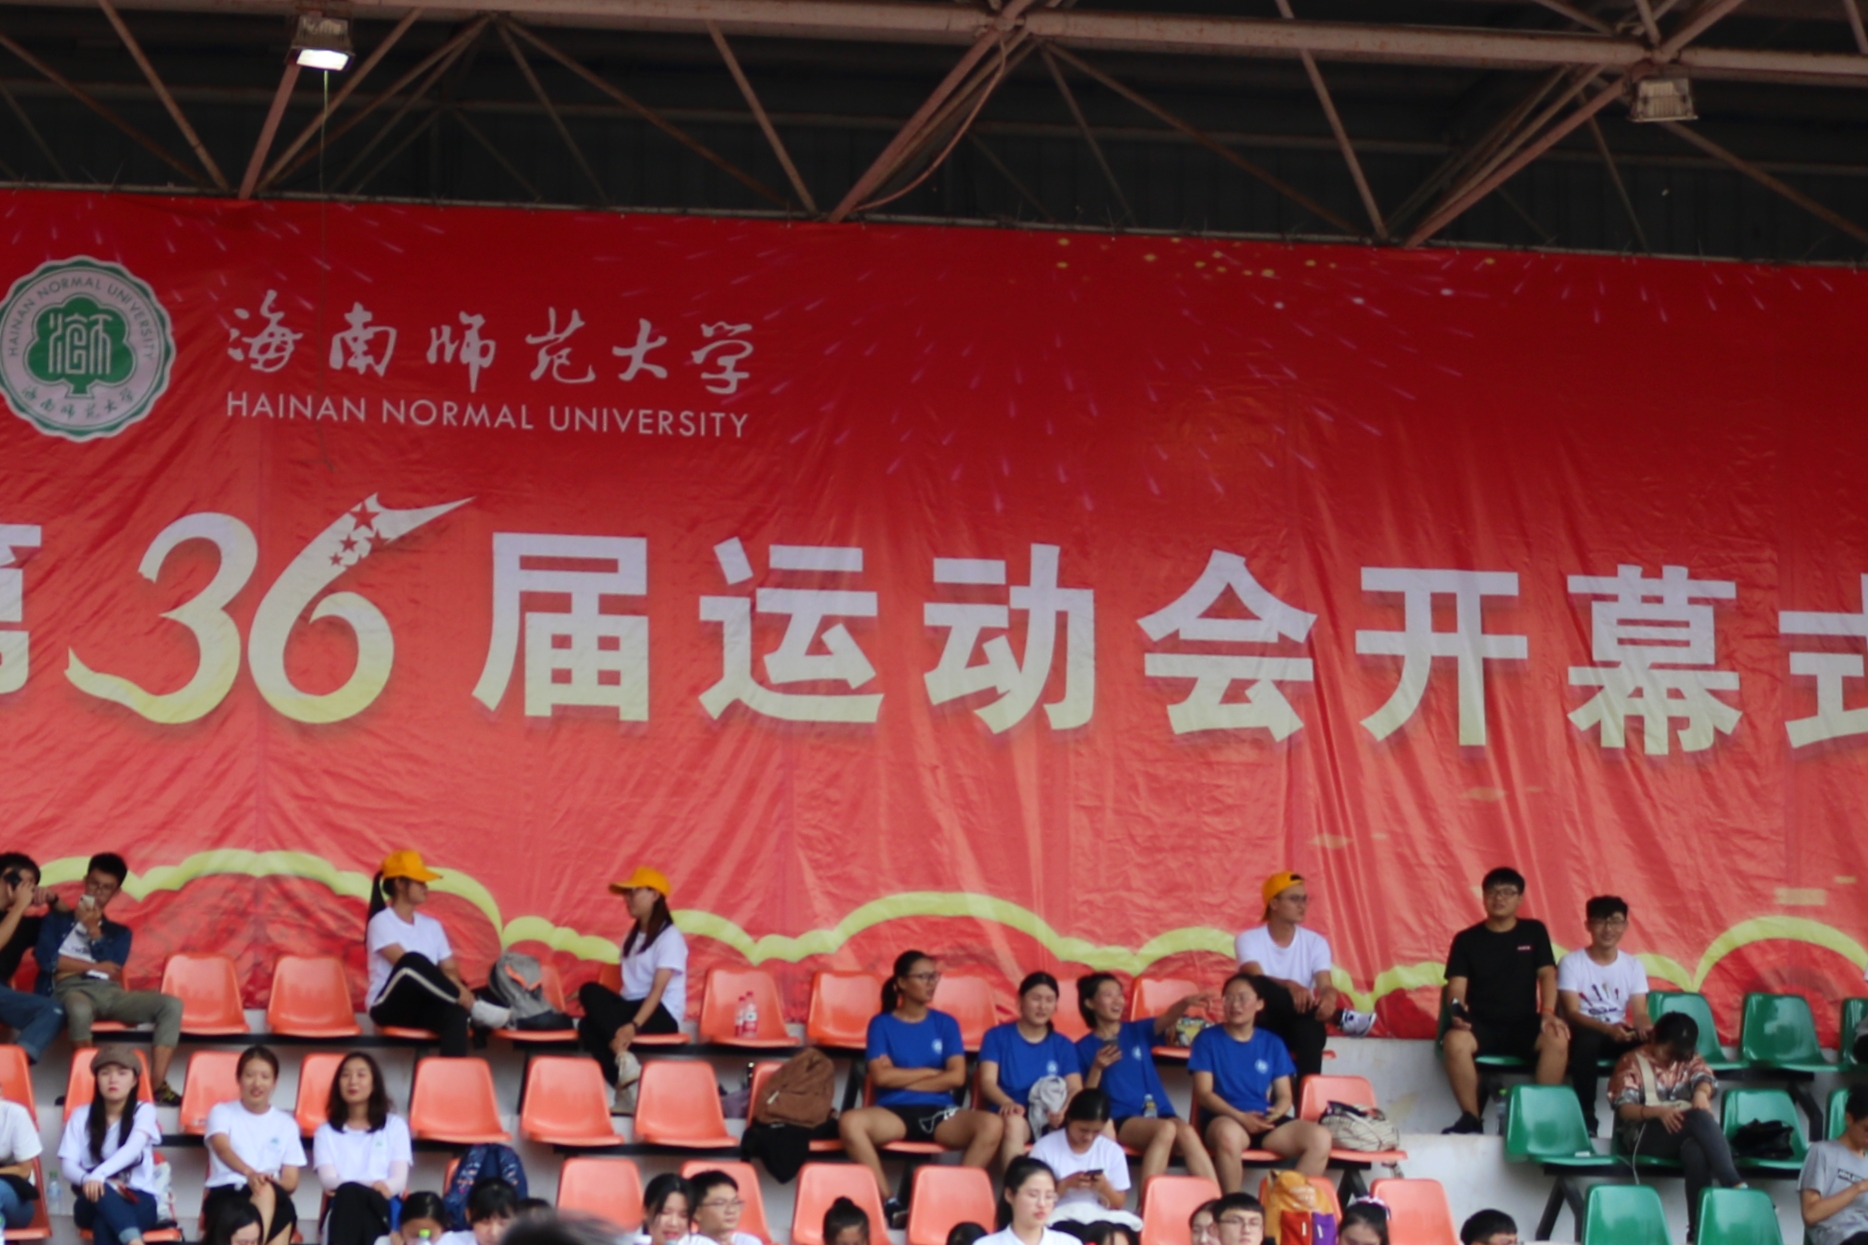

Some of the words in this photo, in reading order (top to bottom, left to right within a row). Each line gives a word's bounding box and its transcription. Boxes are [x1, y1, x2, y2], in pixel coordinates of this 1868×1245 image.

[8, 298, 36, 357] HAINAN
[37, 277, 102, 299] NORMAL
[107, 283, 154, 360] UNIVERSITY
[227, 289, 754, 395] 海南师范大学
[227, 391, 366, 423] HAINAN
[382, 398, 534, 430] NORMAL
[549, 405, 749, 438] UNIVERSITY
